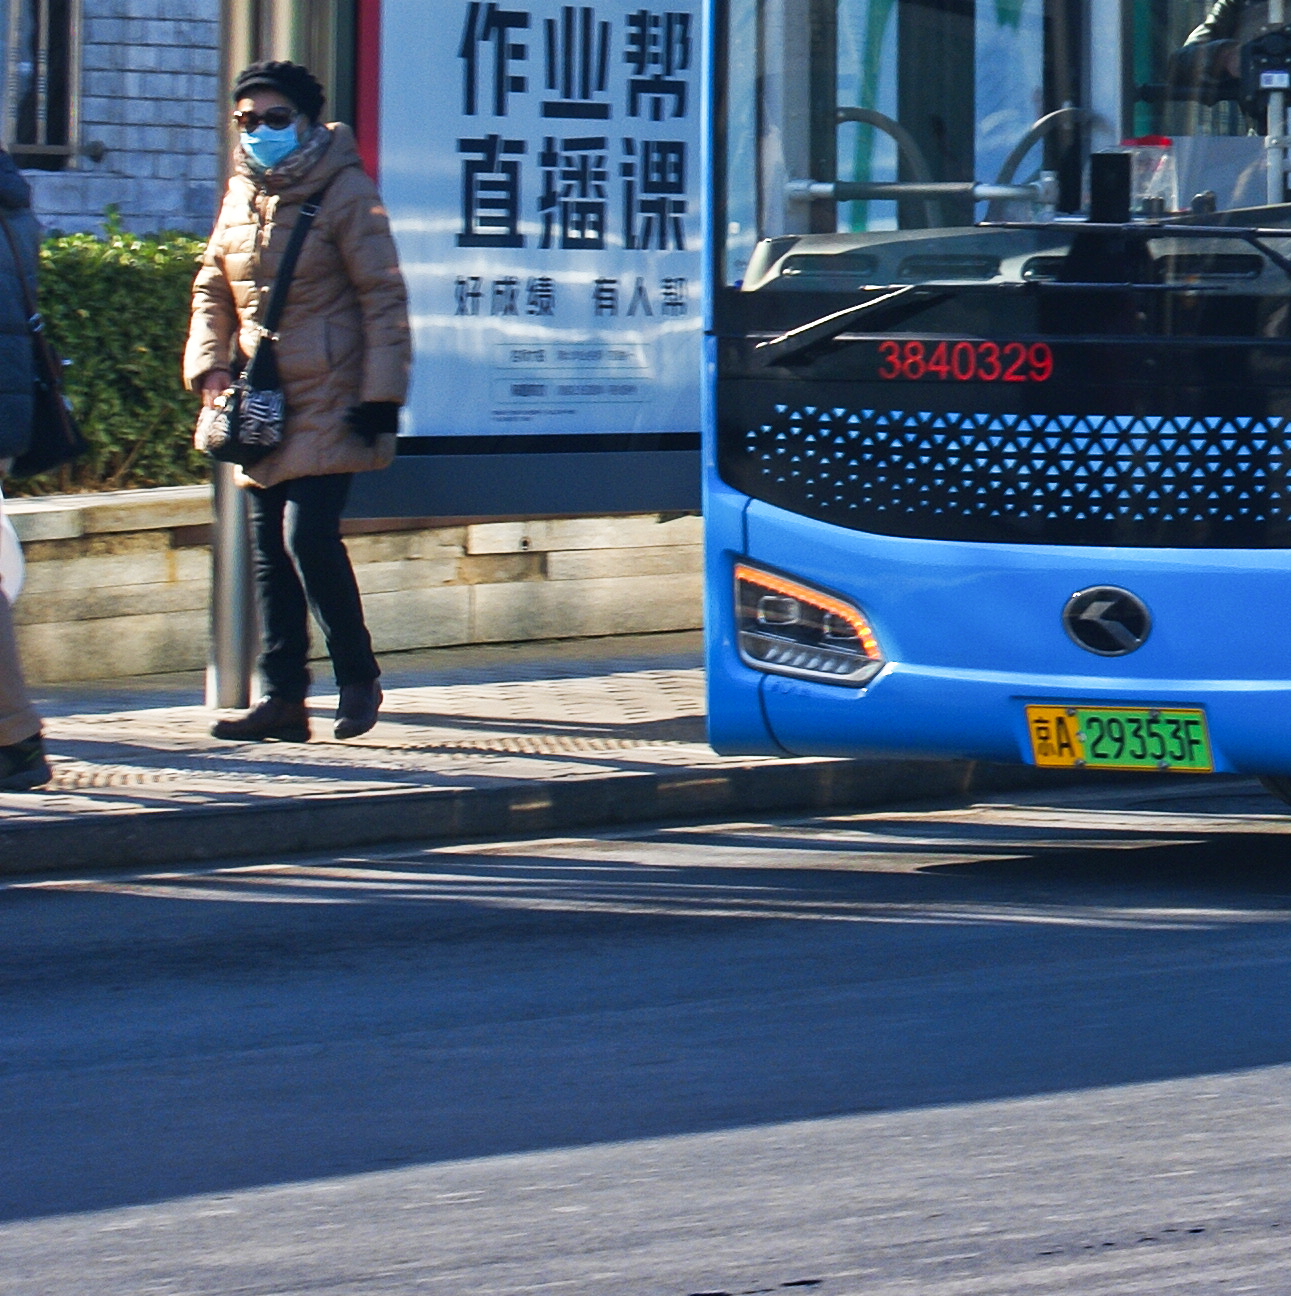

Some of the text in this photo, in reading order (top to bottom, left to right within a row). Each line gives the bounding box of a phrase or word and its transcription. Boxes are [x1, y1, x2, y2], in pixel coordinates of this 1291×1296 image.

[457, 2, 692, 121] 作业帮
[456, 133, 688, 250] 直播课
[454, 275, 688, 317] 好成绩 有人帮
[878, 341, 1053, 382] 3840329
